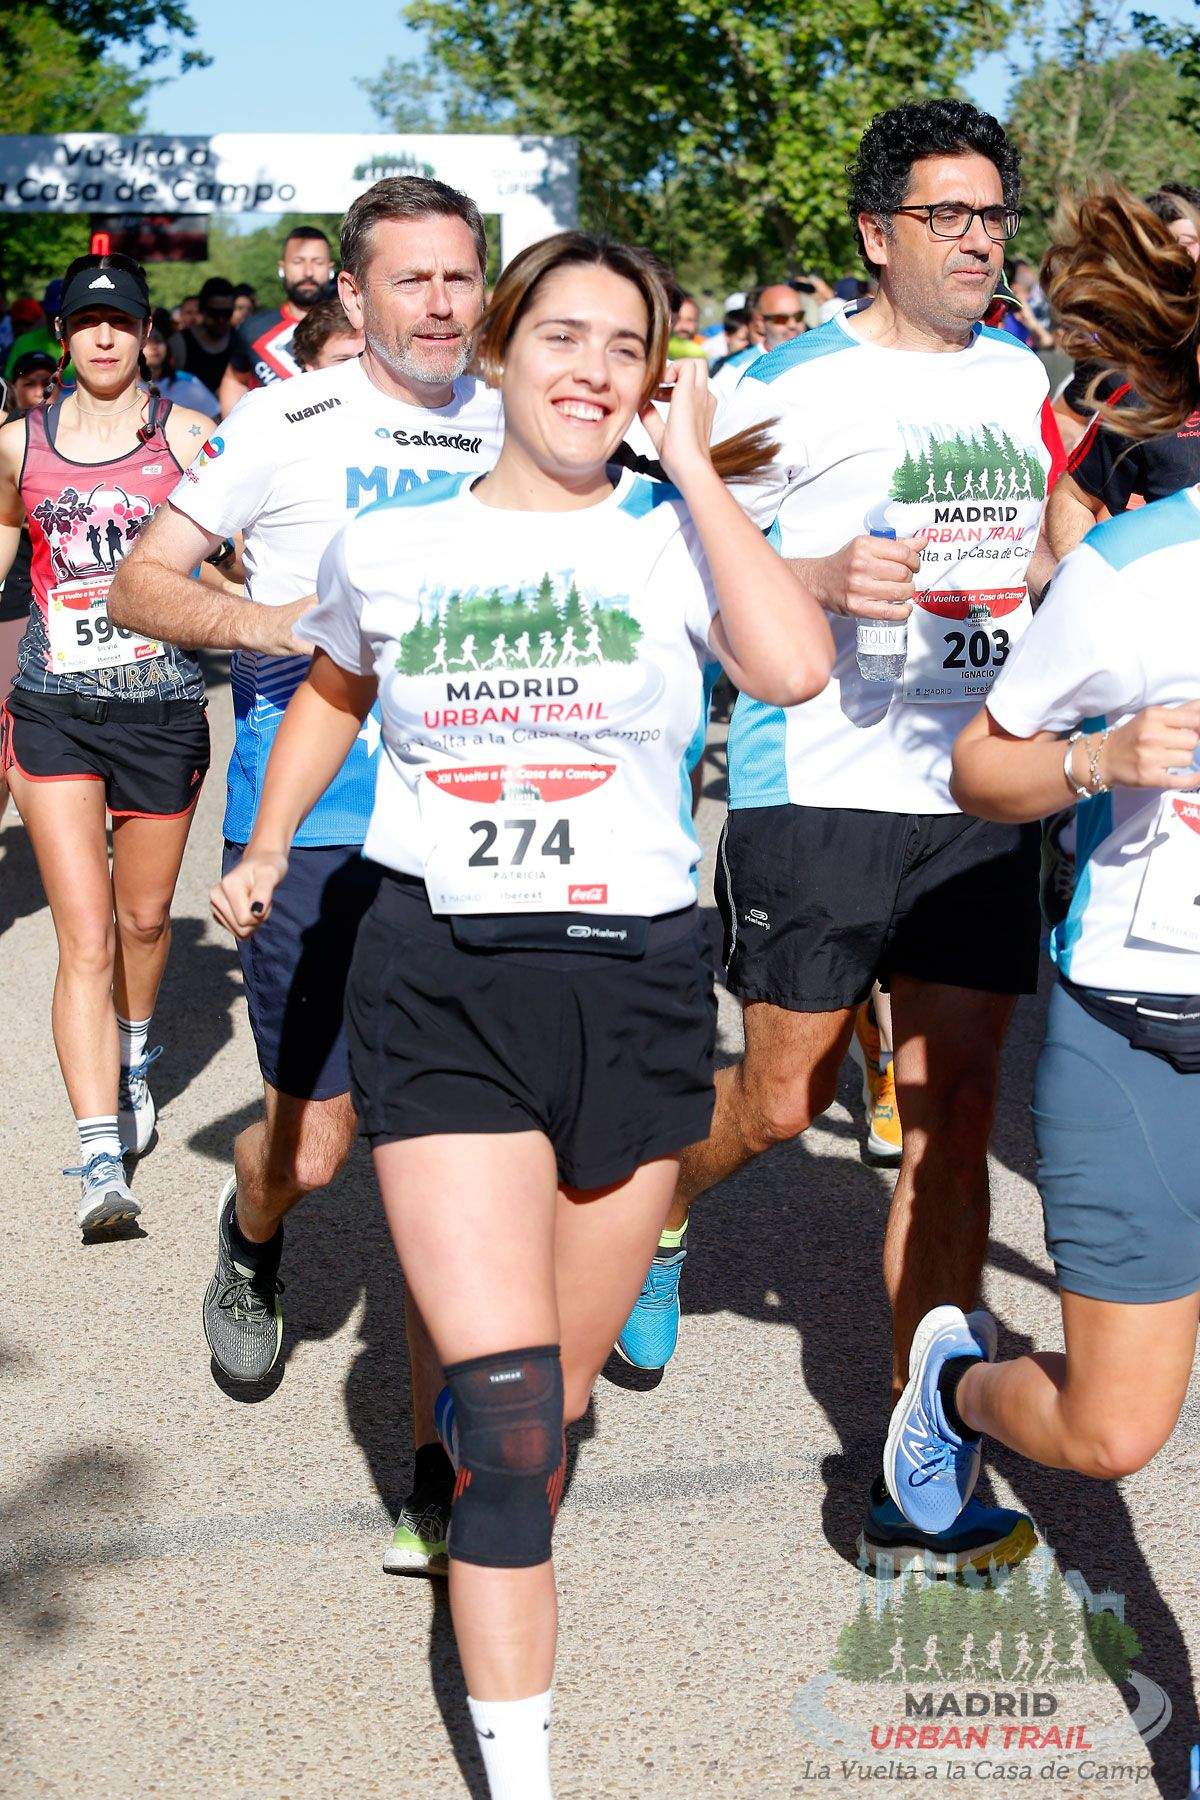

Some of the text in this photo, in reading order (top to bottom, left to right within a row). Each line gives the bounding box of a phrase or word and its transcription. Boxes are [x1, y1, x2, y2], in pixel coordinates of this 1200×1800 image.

[61, 143, 209, 167] Vuelta a
[17, 178, 103, 201] Casa
[115, 178, 157, 201] de
[172, 178, 296, 210] Campo
[392, 430, 483, 454] Sabadell
[934, 506, 1018, 523] MADRID
[988, 527, 1025, 542] TRAIL
[968, 546, 999, 560] Casa
[933, 595, 960, 603] Vuelta
[961, 669, 995, 678] IGNACIO
[446, 677, 579, 701] MADRID
[424, 702, 609, 729] URBAN TRAIL
[453, 771, 489, 784] Vuelta
[566, 768, 608, 782] Campo
[468, 818, 576, 868] 274
[493, 871, 546, 880] PATRICIA
